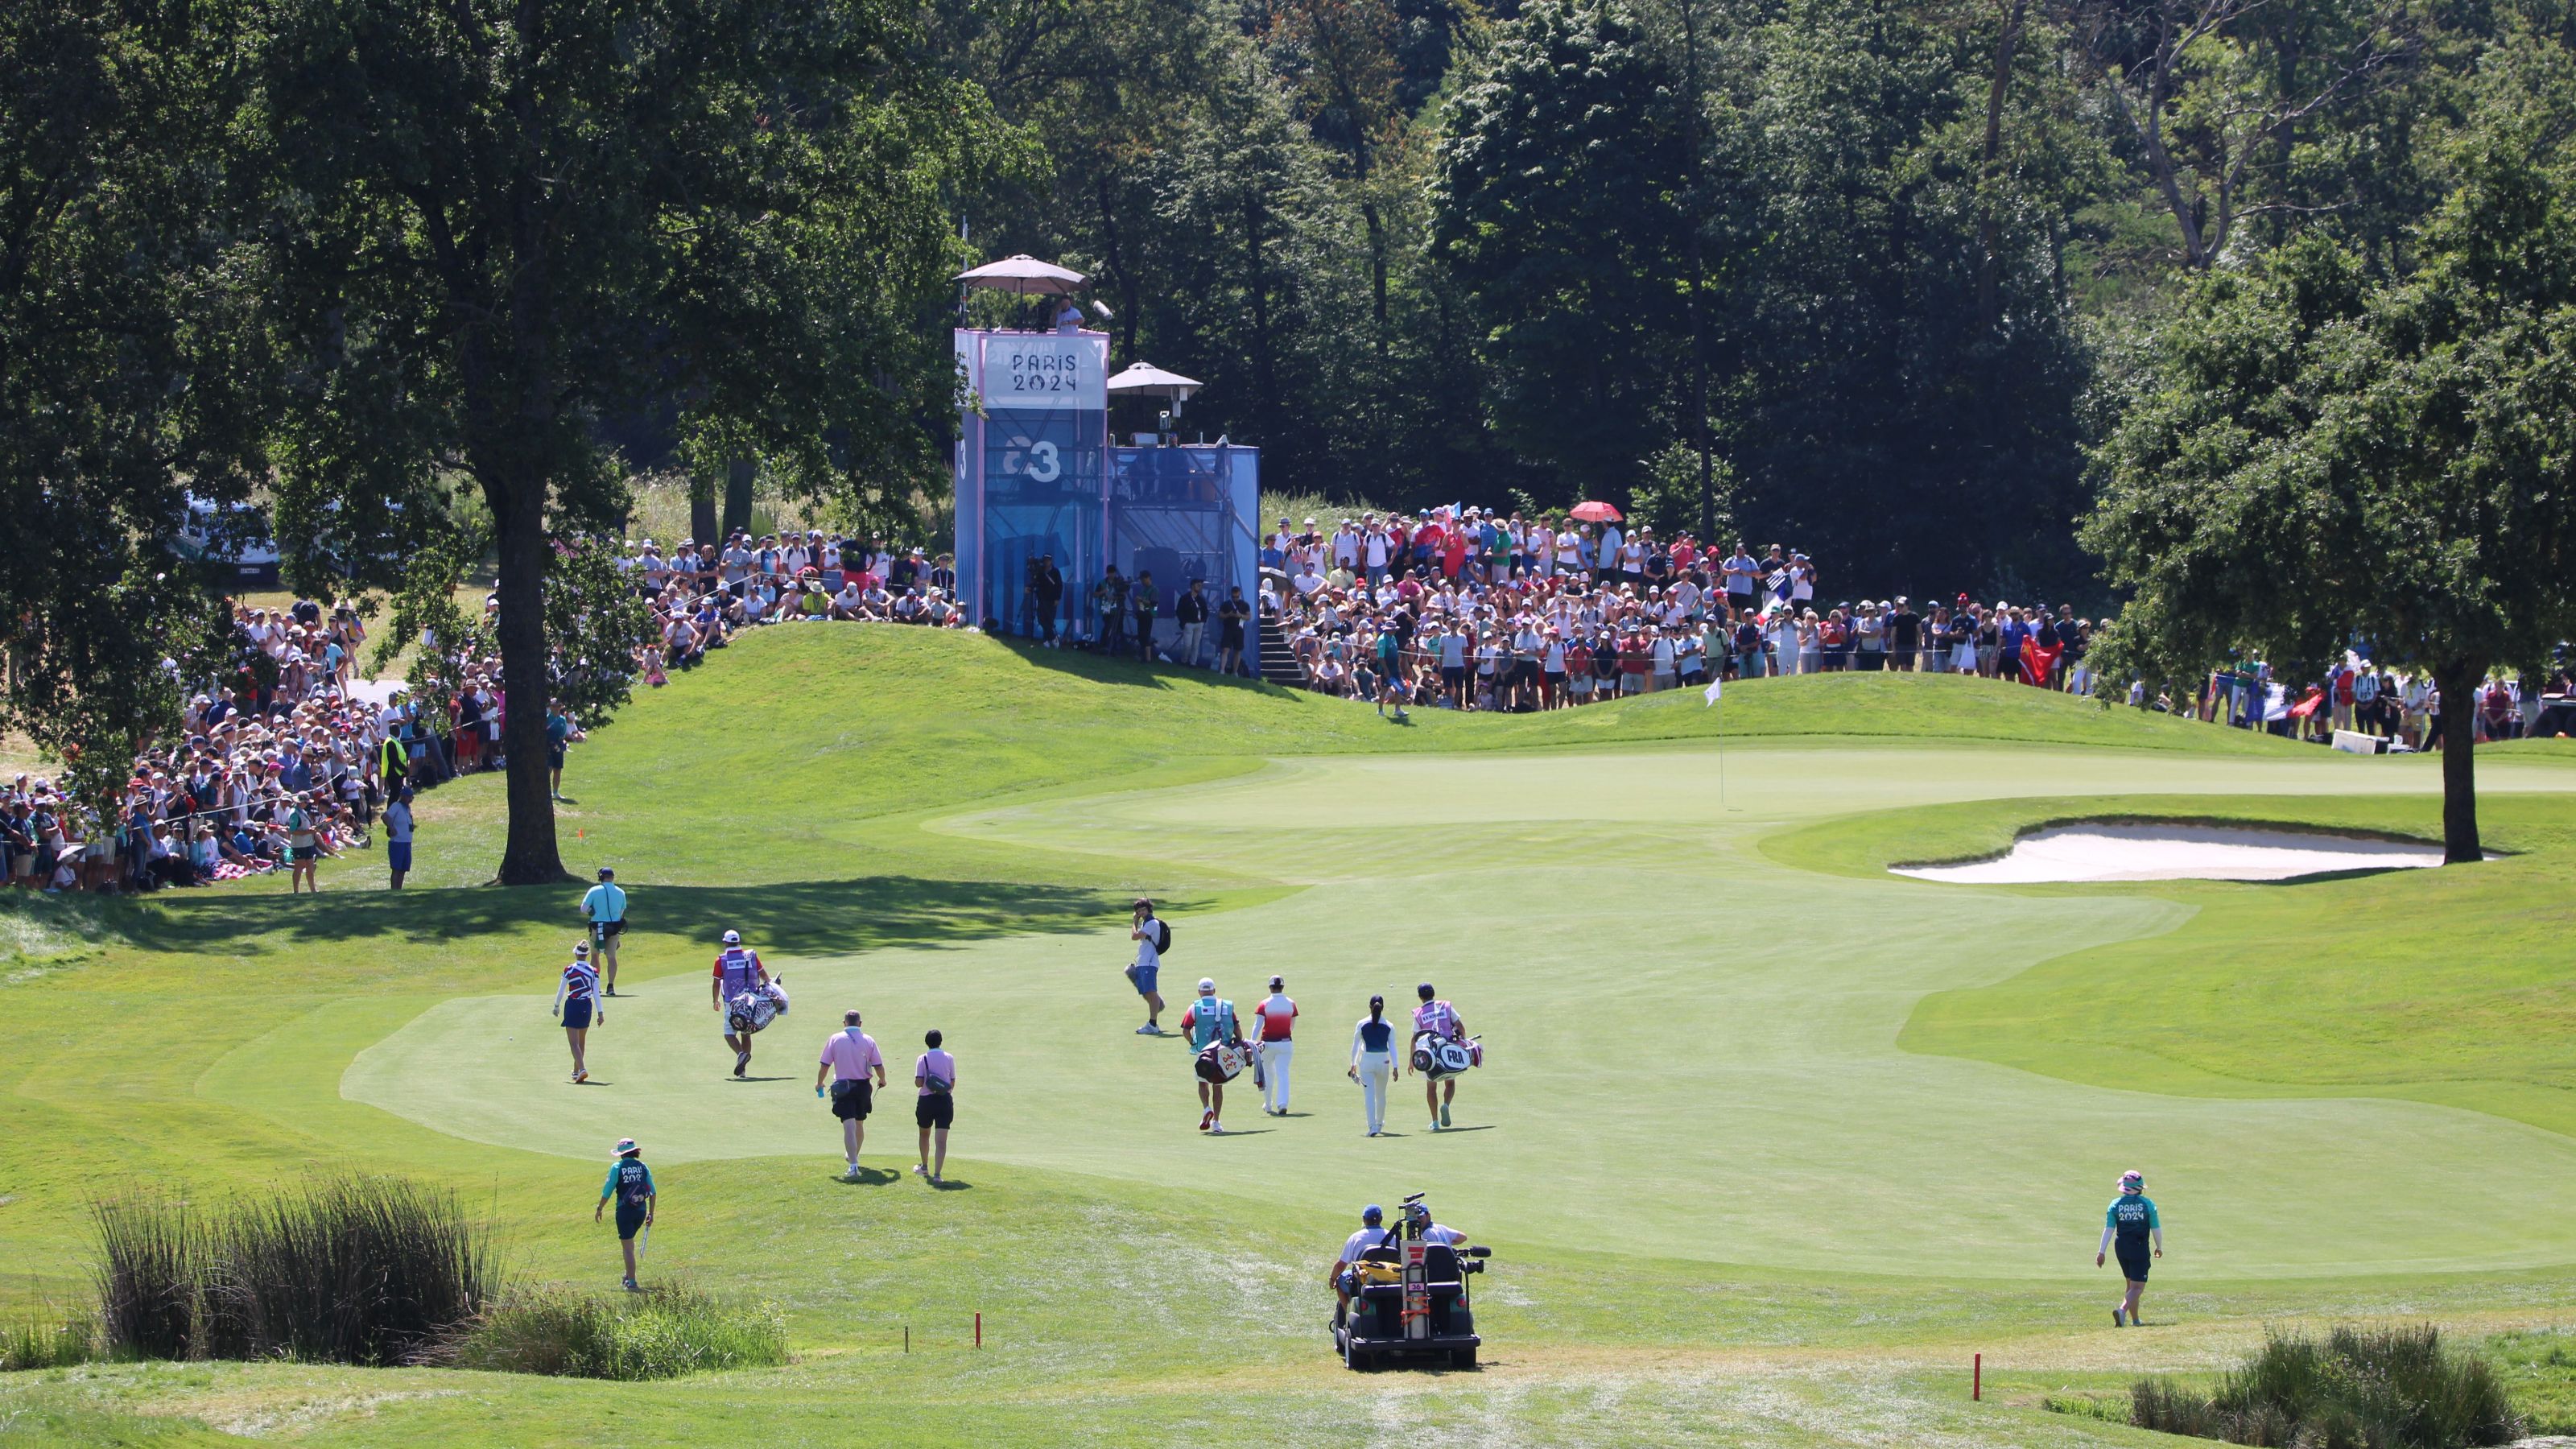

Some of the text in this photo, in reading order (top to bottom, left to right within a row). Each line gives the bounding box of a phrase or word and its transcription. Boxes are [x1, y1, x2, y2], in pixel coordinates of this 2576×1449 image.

[1013, 374, 1076, 391] 2024
[960, 438, 967, 480] 3
[1029, 440, 1061, 483] 3
[1447, 1049, 1465, 1064] FRA
[622, 1174, 642, 1183] 202
[2118, 1211, 2145, 1221] 2024
